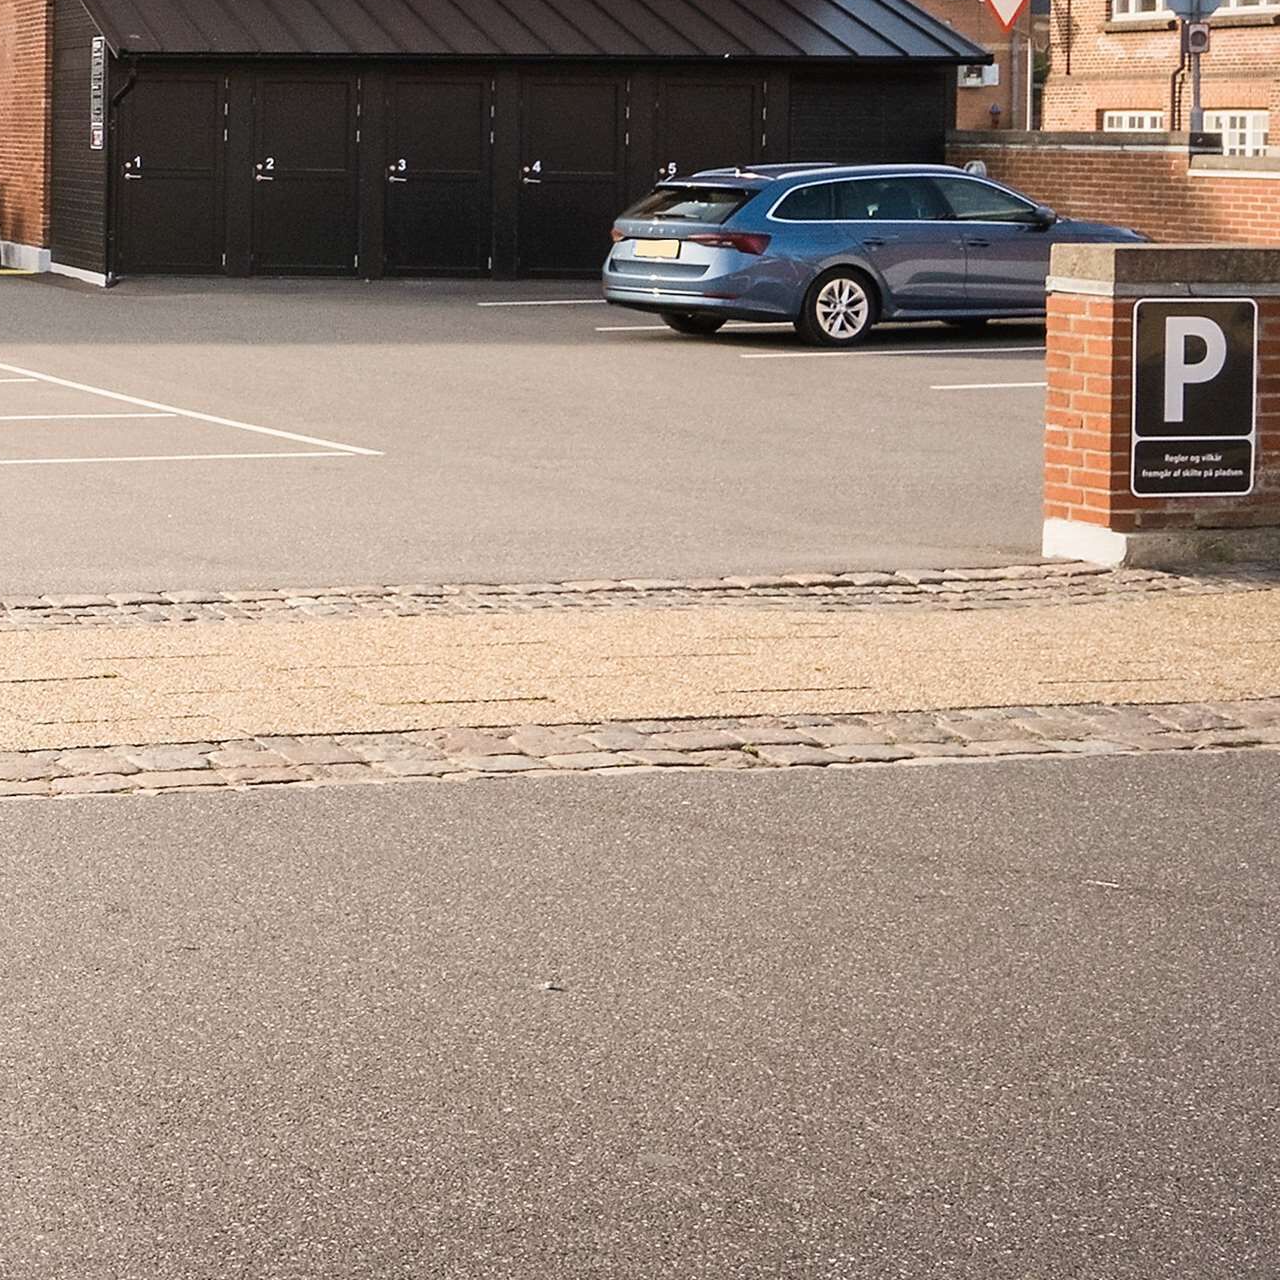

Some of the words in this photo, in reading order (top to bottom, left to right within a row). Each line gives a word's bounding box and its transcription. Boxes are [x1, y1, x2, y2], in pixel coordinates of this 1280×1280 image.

[134, 155, 141, 168] 1
[265, 157, 274, 170] 2
[397, 158, 407, 171] 3
[532, 160, 541, 173] 4
[668, 162, 677, 174] 5
[1163, 316, 1227, 423] P
[1164, 454, 1189, 464] Regler
[1190, 455, 1200, 463] og
